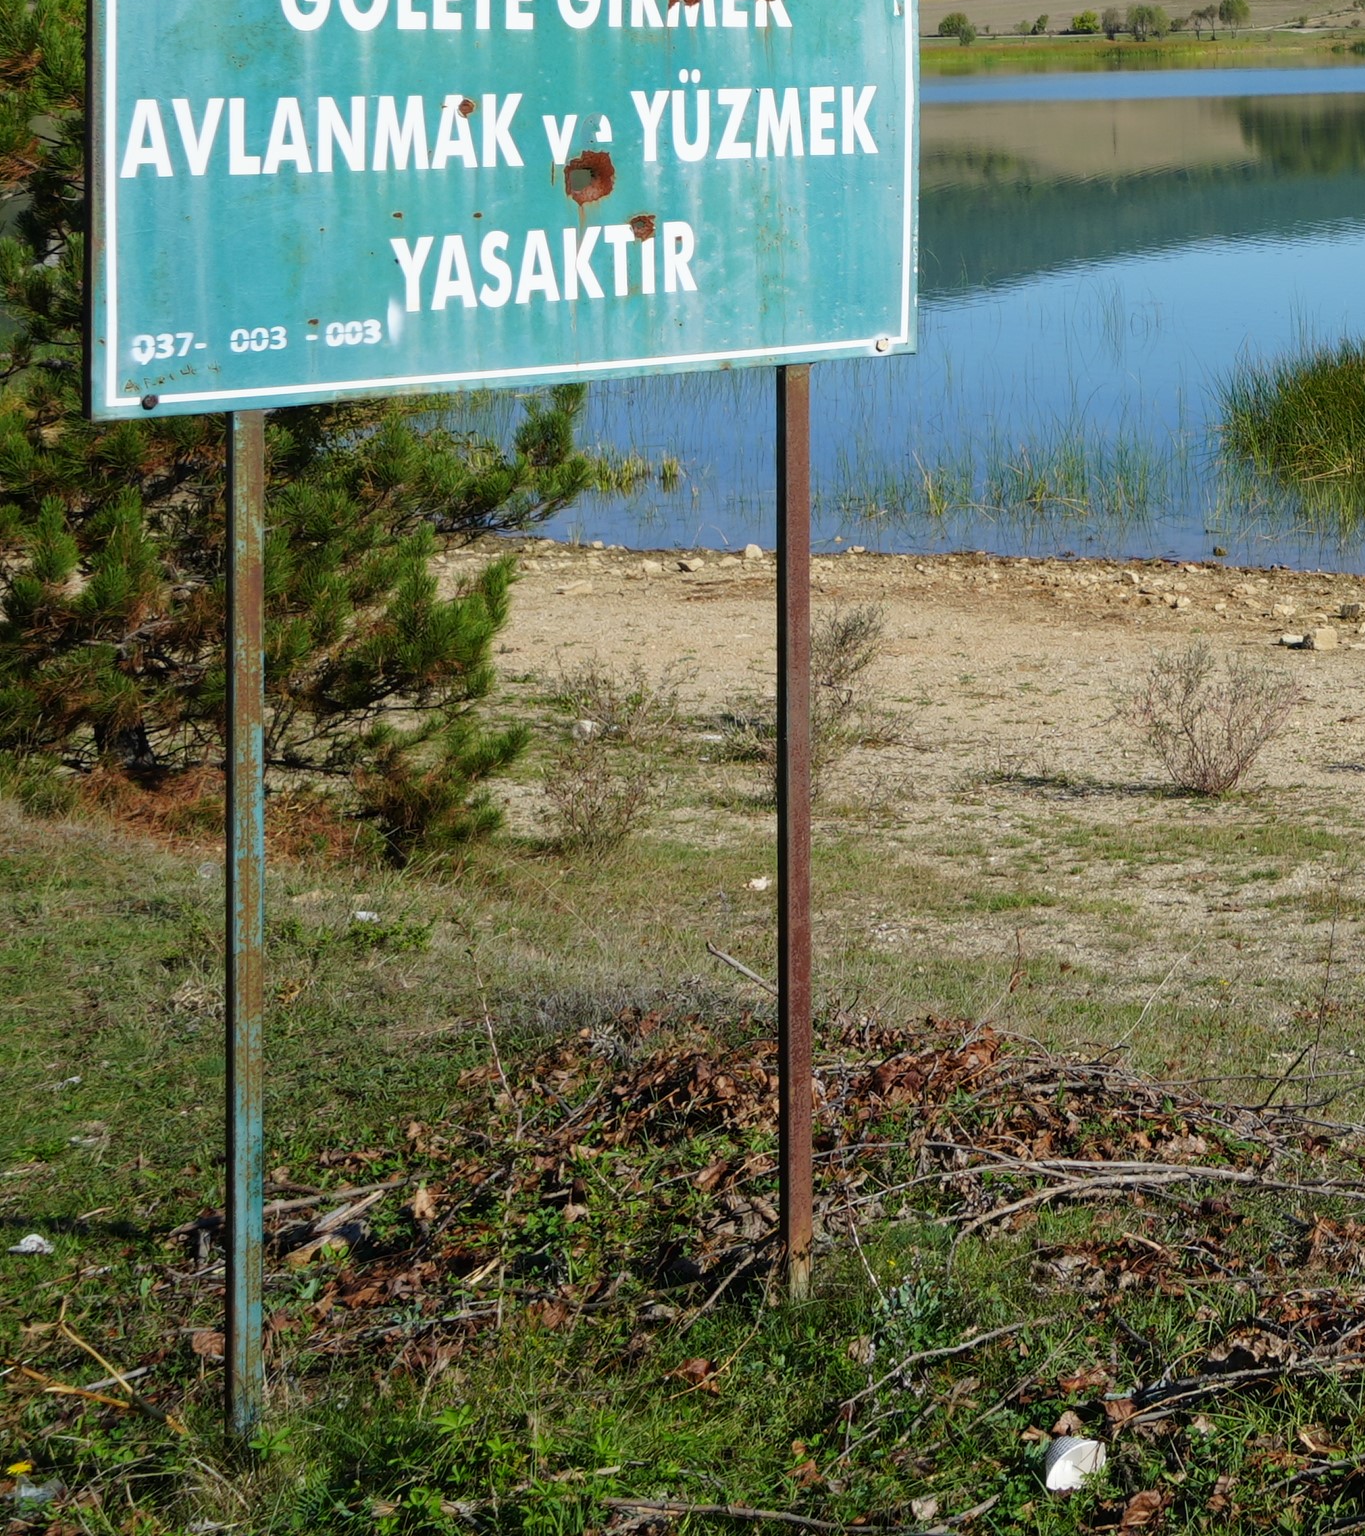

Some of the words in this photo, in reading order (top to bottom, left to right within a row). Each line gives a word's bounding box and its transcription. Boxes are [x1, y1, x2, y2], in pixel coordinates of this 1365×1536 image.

[120, 93, 524, 179] AVLANMAK
[630, 69, 880, 163] YÜZMEK
[389, 221, 698, 312] YASAKTIR
[229, 326, 288, 353] 003
